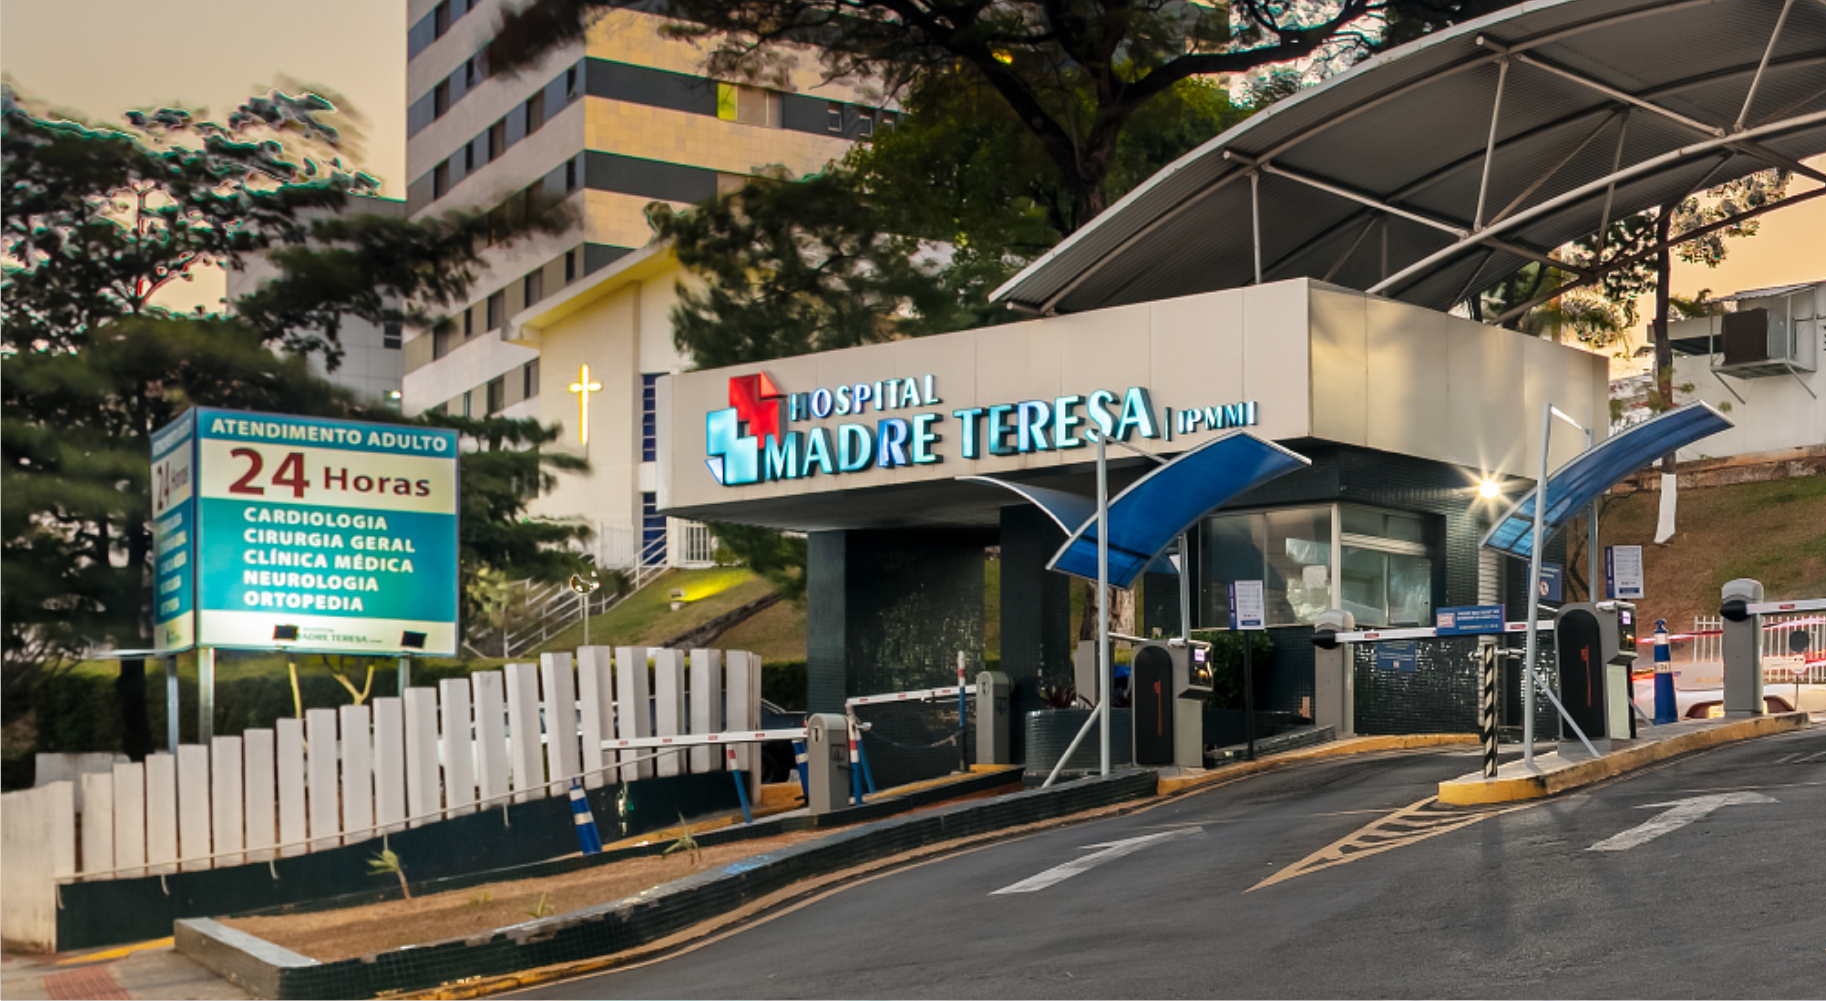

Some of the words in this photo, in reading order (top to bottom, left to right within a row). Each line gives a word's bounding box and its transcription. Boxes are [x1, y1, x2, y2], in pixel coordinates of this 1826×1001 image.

[789, 373, 942, 421] HOSPITAL
[211, 417, 362, 445] ATENDIMENTO
[367, 431, 448, 452] ADULTO
[764, 413, 943, 480] MADRE
[953, 386, 1160, 459] TERESA
[1177, 400, 1258, 434] IPMMI
[156, 461, 170, 511] 24
[228, 446, 310, 499] 24
[323, 466, 431, 497] Horas
[243, 506, 388, 531] CARDIOLOGIA
[243, 528, 344, 549] CIRURGIA
[350, 536, 416, 553] GERAL
[243, 548, 328, 569] CLÍNICA
[334, 554, 414, 574] MÉDICA
[243, 570, 379, 592] NEUROLOGIA
[243, 591, 363, 612] ORTOPEDIA
